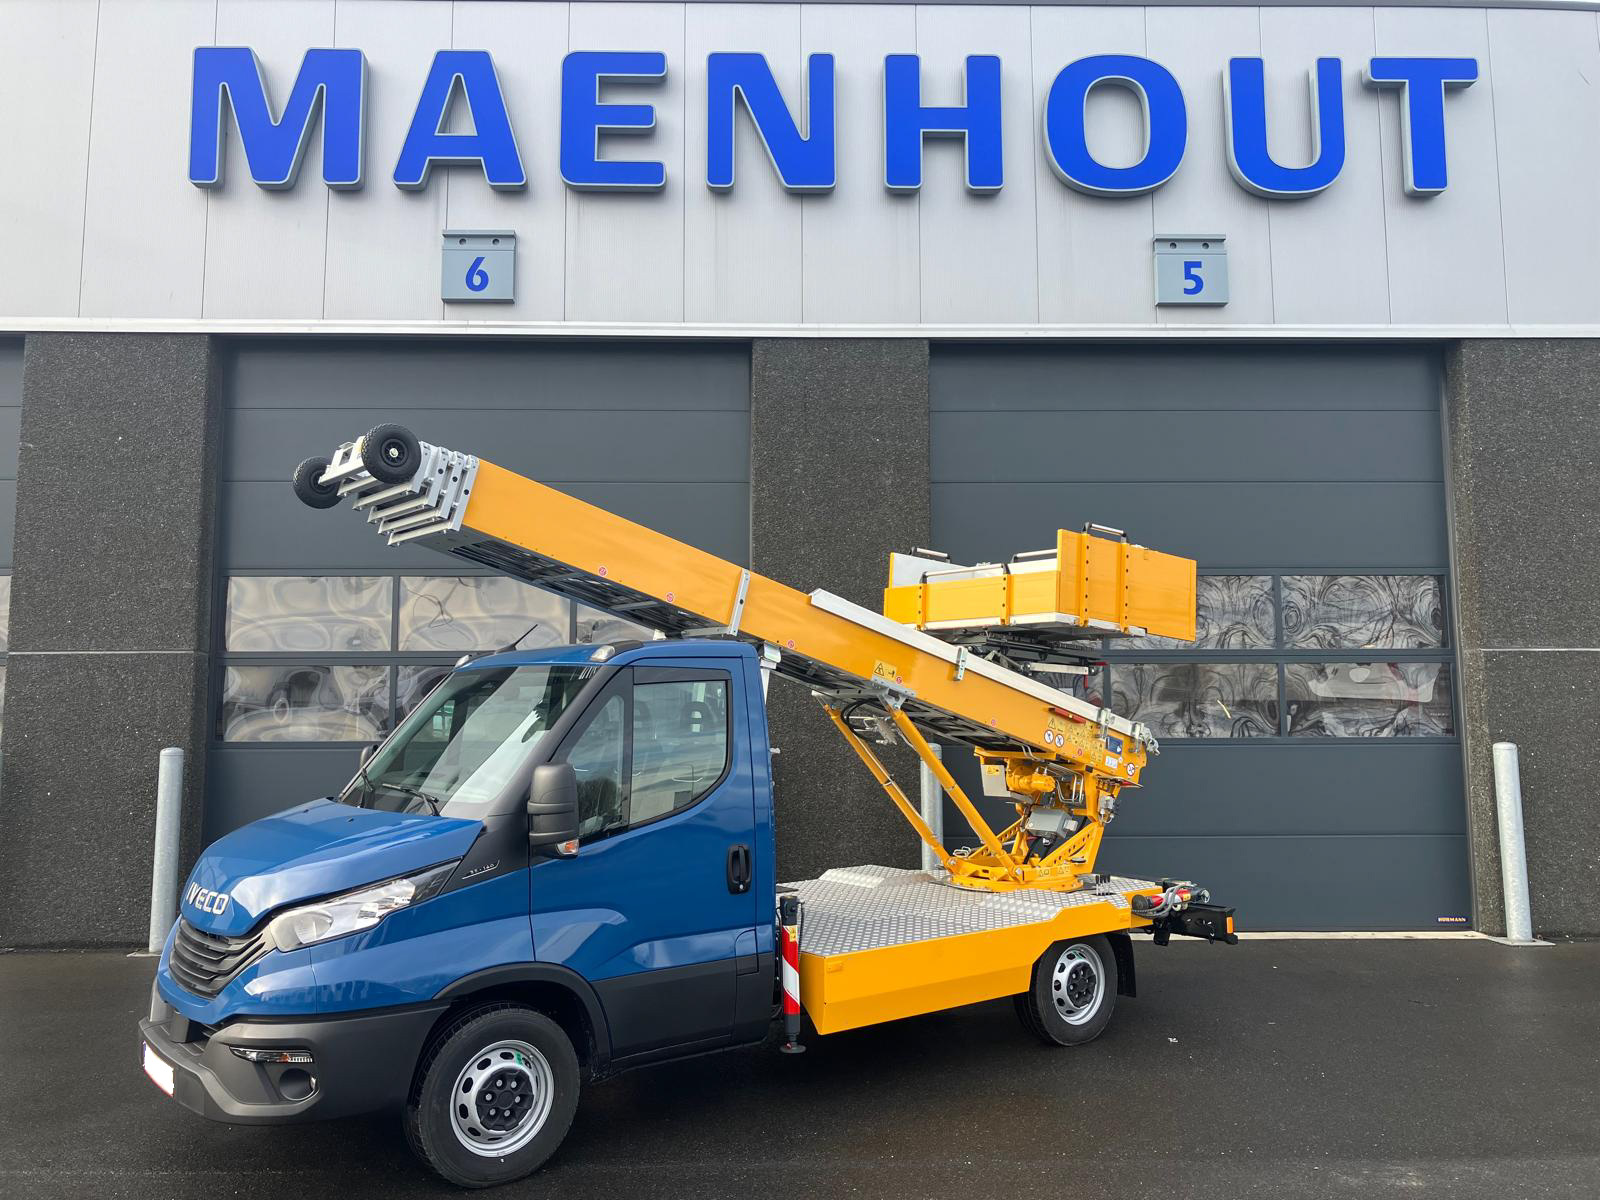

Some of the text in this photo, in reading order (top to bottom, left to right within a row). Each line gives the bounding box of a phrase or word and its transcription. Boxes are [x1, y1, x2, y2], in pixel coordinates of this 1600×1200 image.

[188, 47, 1479, 195] MAENHOUT
[465, 256, 489, 292] 6
[1183, 261, 1204, 296] 5
[186, 881, 229, 915] IVECO
